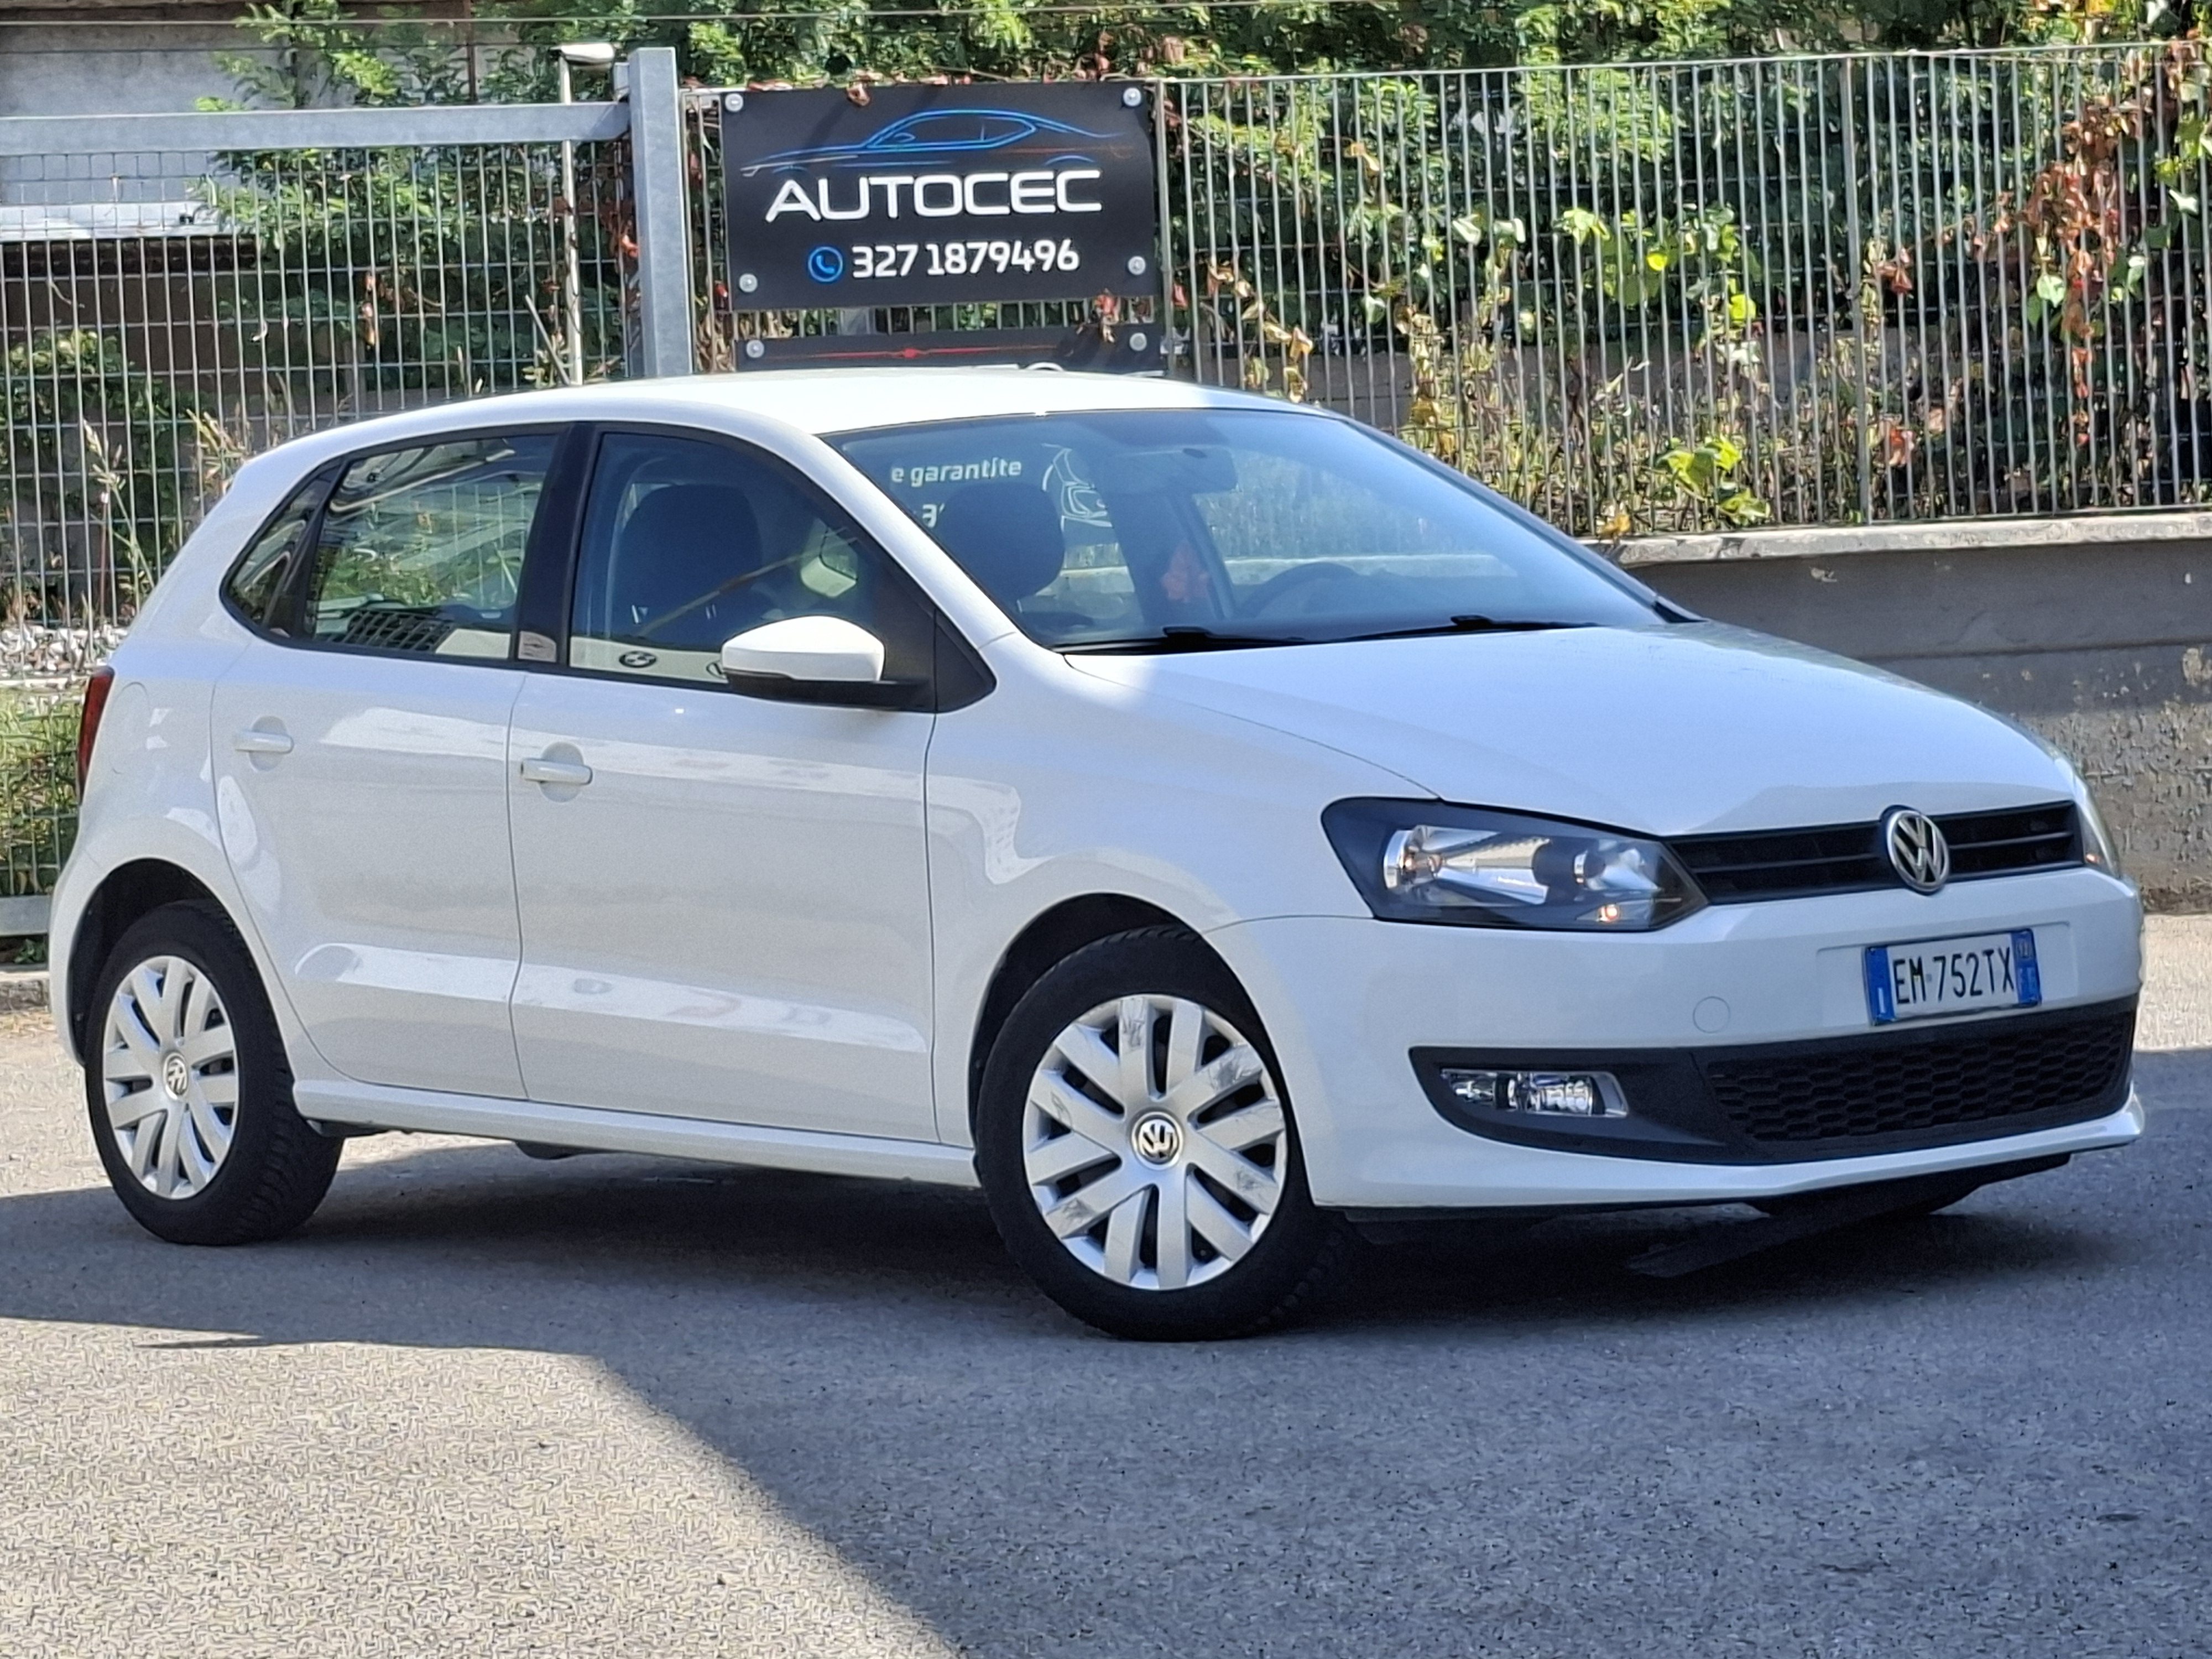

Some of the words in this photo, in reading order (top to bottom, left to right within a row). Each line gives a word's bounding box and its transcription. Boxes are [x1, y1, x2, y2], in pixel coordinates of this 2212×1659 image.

[765, 169, 1102, 222] AUTOCEC
[852, 243, 919, 279] 327
[926, 238, 1080, 277] 1879496
[891, 467, 905, 483] e
[910, 456, 1022, 488] garantite
